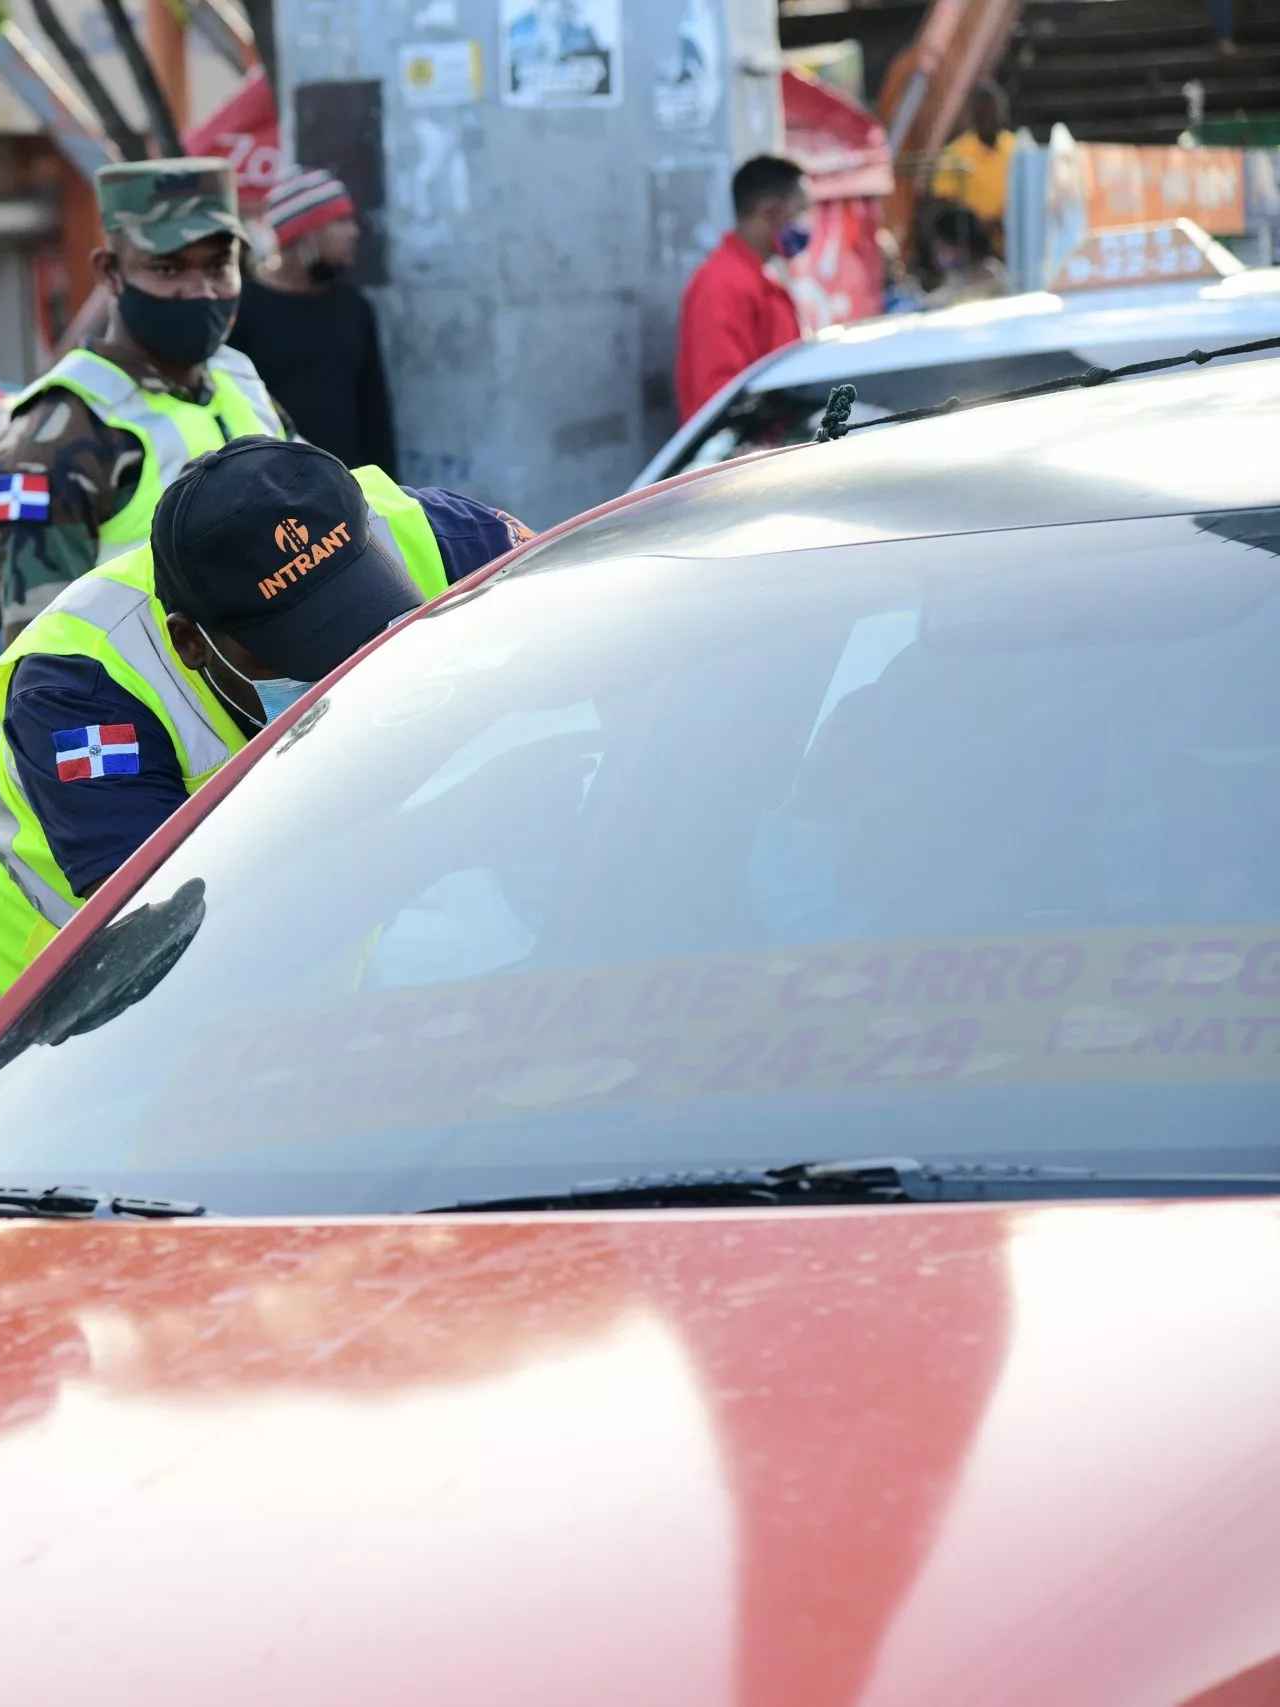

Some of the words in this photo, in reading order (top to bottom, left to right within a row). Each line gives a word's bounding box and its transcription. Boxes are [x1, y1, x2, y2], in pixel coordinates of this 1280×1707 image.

[258, 521, 352, 600] INTRANT
[628, 962, 756, 1023] DE
[778, 940, 1086, 1012] CARRO
[1042, 1017, 1280, 1054] FENAT
